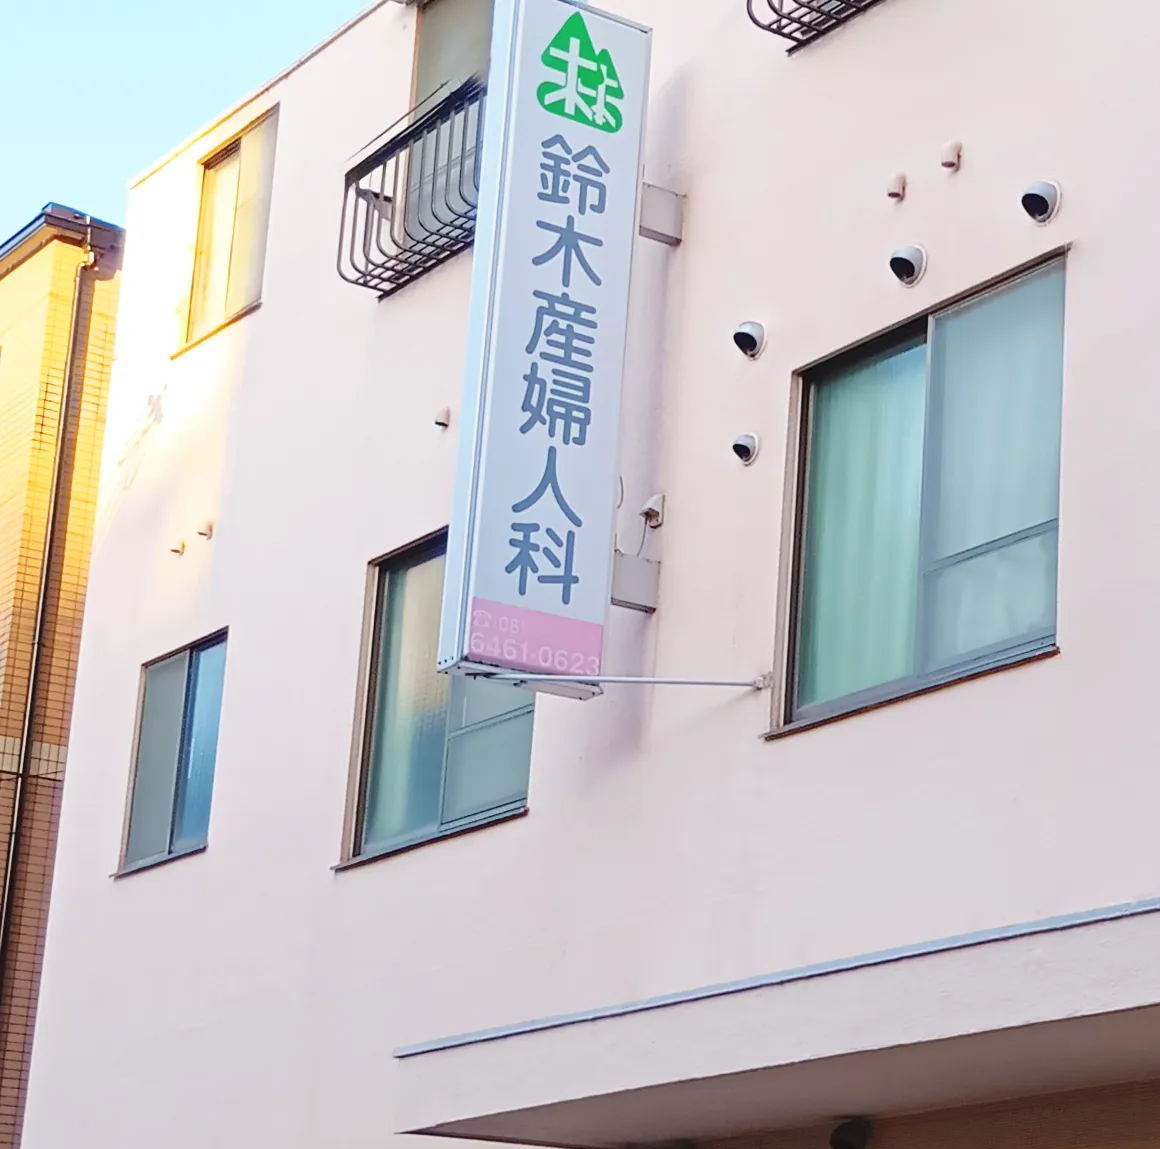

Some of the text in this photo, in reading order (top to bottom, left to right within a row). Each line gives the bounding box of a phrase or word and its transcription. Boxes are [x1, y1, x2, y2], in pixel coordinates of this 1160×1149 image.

[504, 133, 611, 606] 鈴木産婦人科
